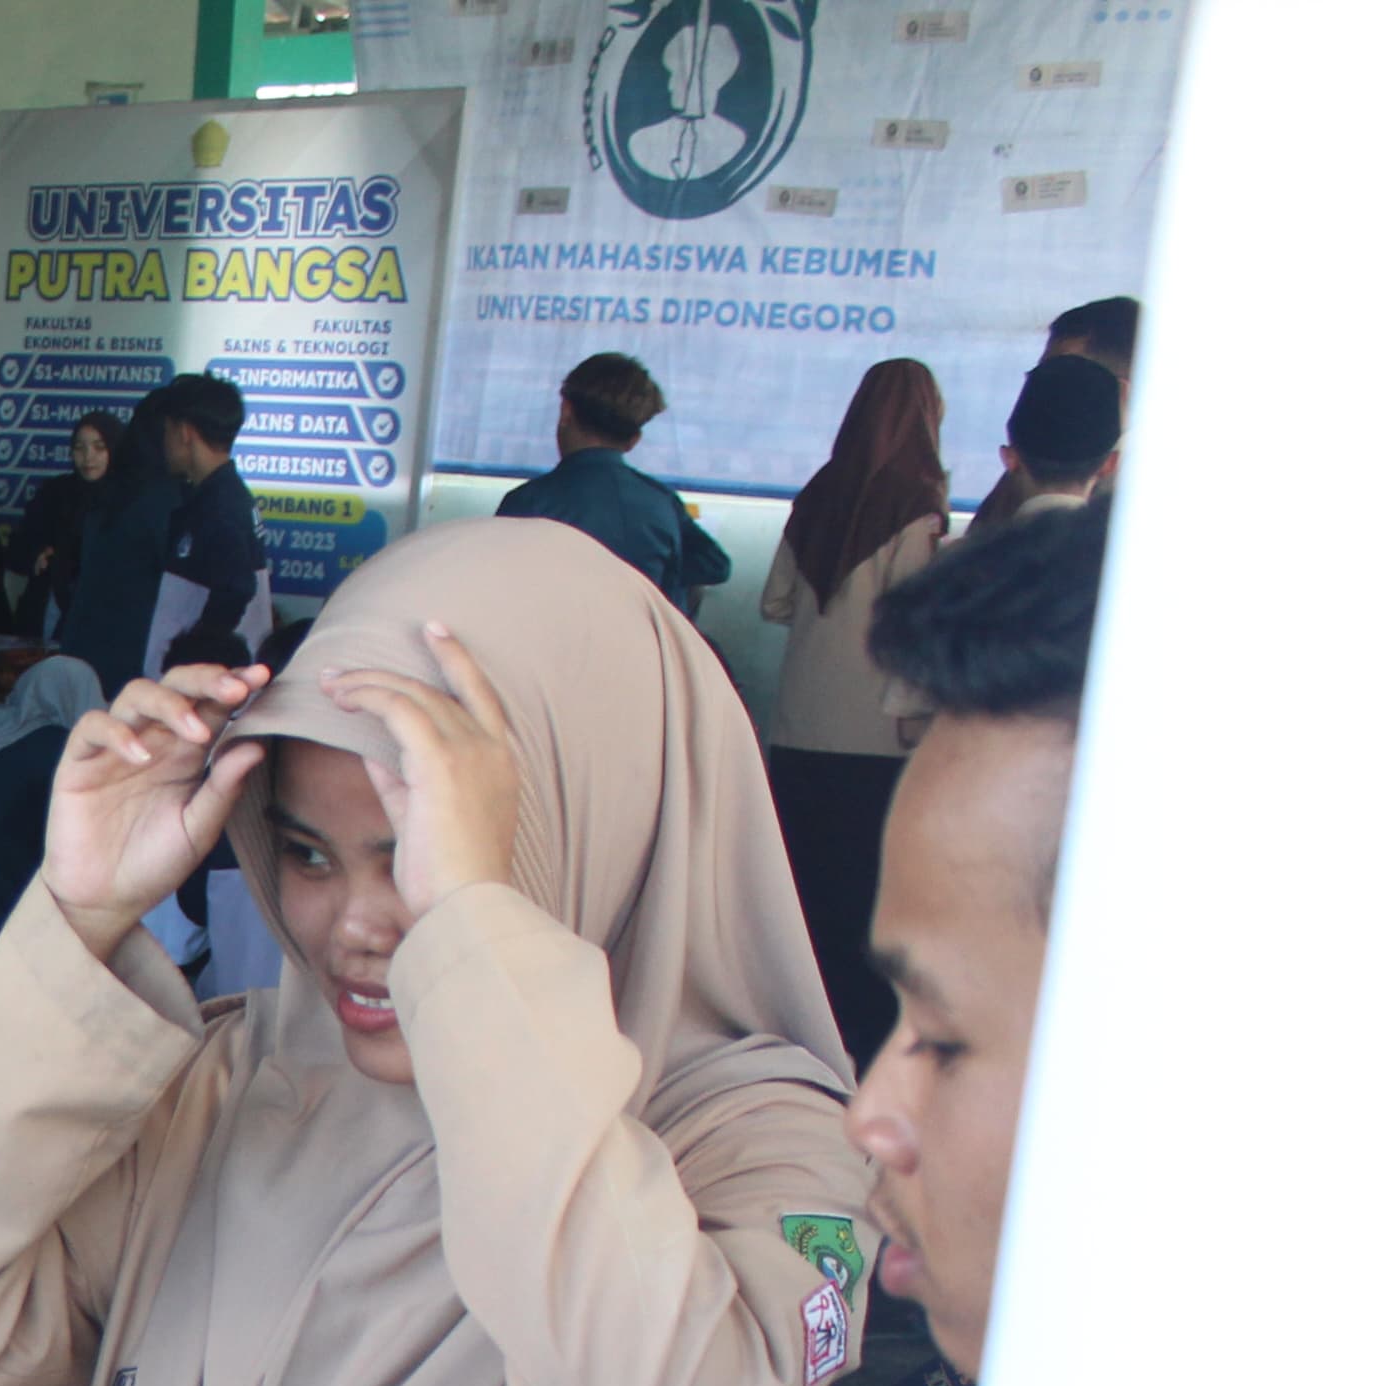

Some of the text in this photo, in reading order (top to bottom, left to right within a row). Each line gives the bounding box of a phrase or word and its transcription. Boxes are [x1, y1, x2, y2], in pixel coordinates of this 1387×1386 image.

[26, 175, 401, 242] UNIVERSITAS
[466, 244, 937, 279] IKATAN MAHASISWA KEBUMEN
[6, 245, 408, 301] PUTRA BANGSA
[26, 316, 92, 331] FAKULTAS
[476, 294, 896, 334] UNIVERSITAS DIPONEGORO
[313, 319, 393, 335] FAKULTAS
[24, 336, 164, 352] EKONOMI & BISNIS
[224, 338, 390, 356] SAINS & TEKNOLOGI
[34, 364, 164, 384] S1-AKUNTANSI
[300, 416, 350, 435] DATA
[343, 501, 353, 517] 1
[291, 530, 336, 551] 2023
[280, 560, 325, 579] 2024
